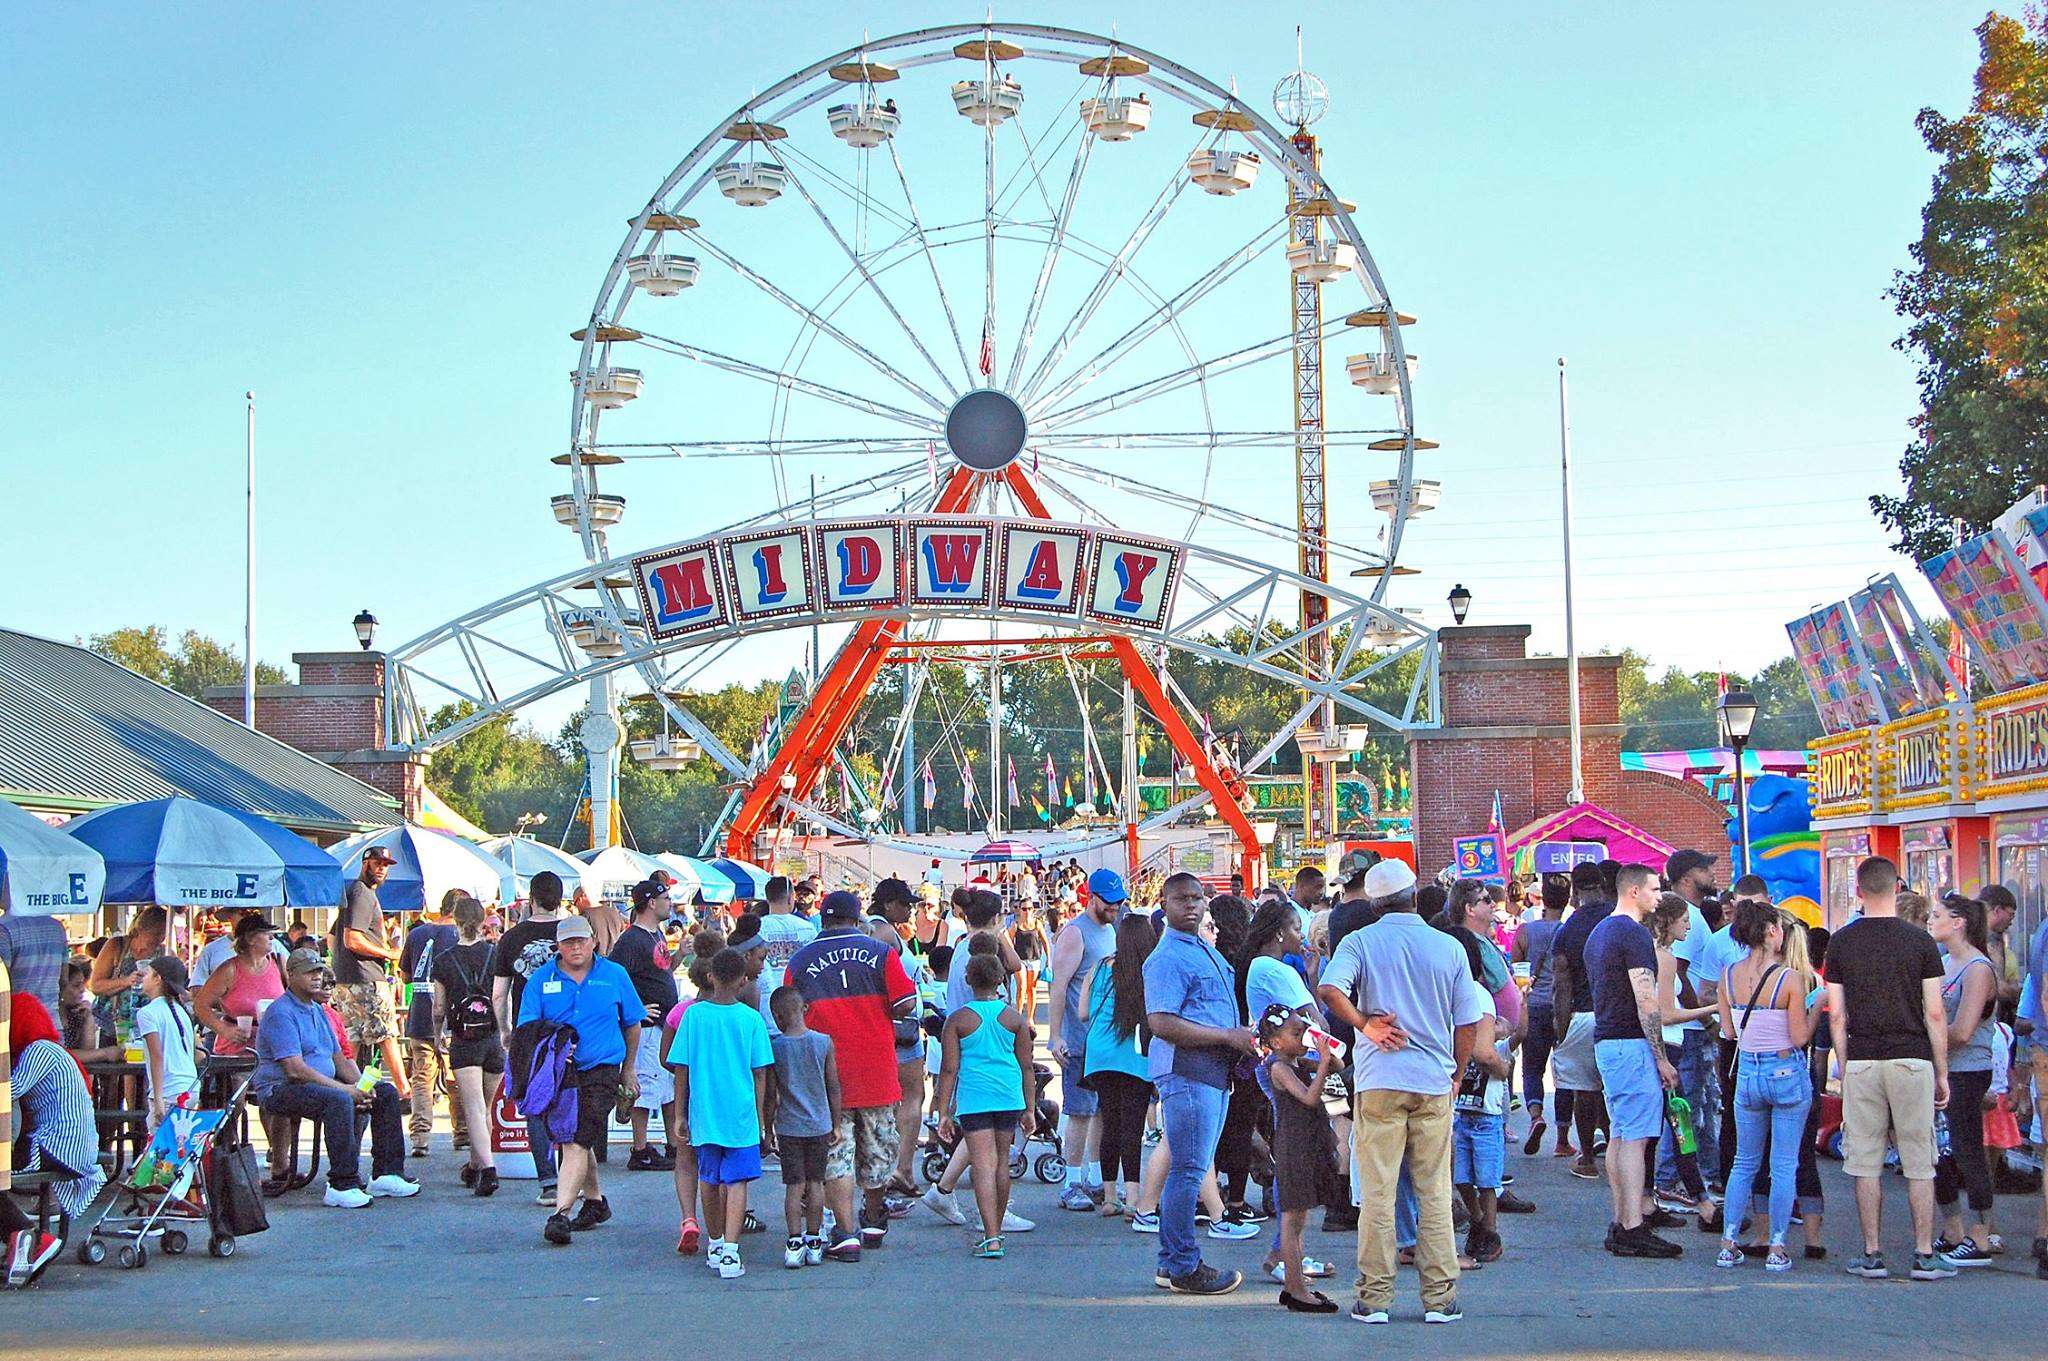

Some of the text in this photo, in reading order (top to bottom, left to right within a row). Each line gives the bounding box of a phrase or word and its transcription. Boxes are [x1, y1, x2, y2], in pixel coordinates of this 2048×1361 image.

[648, 533, 1158, 625] MIDWAY
[1900, 731, 1941, 788] RIDES
[1992, 704, 2048, 774] RIDES
[1822, 749, 1864, 800] RIDES
[27, 873, 88, 906] THE BIG E
[181, 873, 259, 899] THE BIG E
[806, 947, 879, 978] NAUTICA
[840, 969, 848, 989] 1
